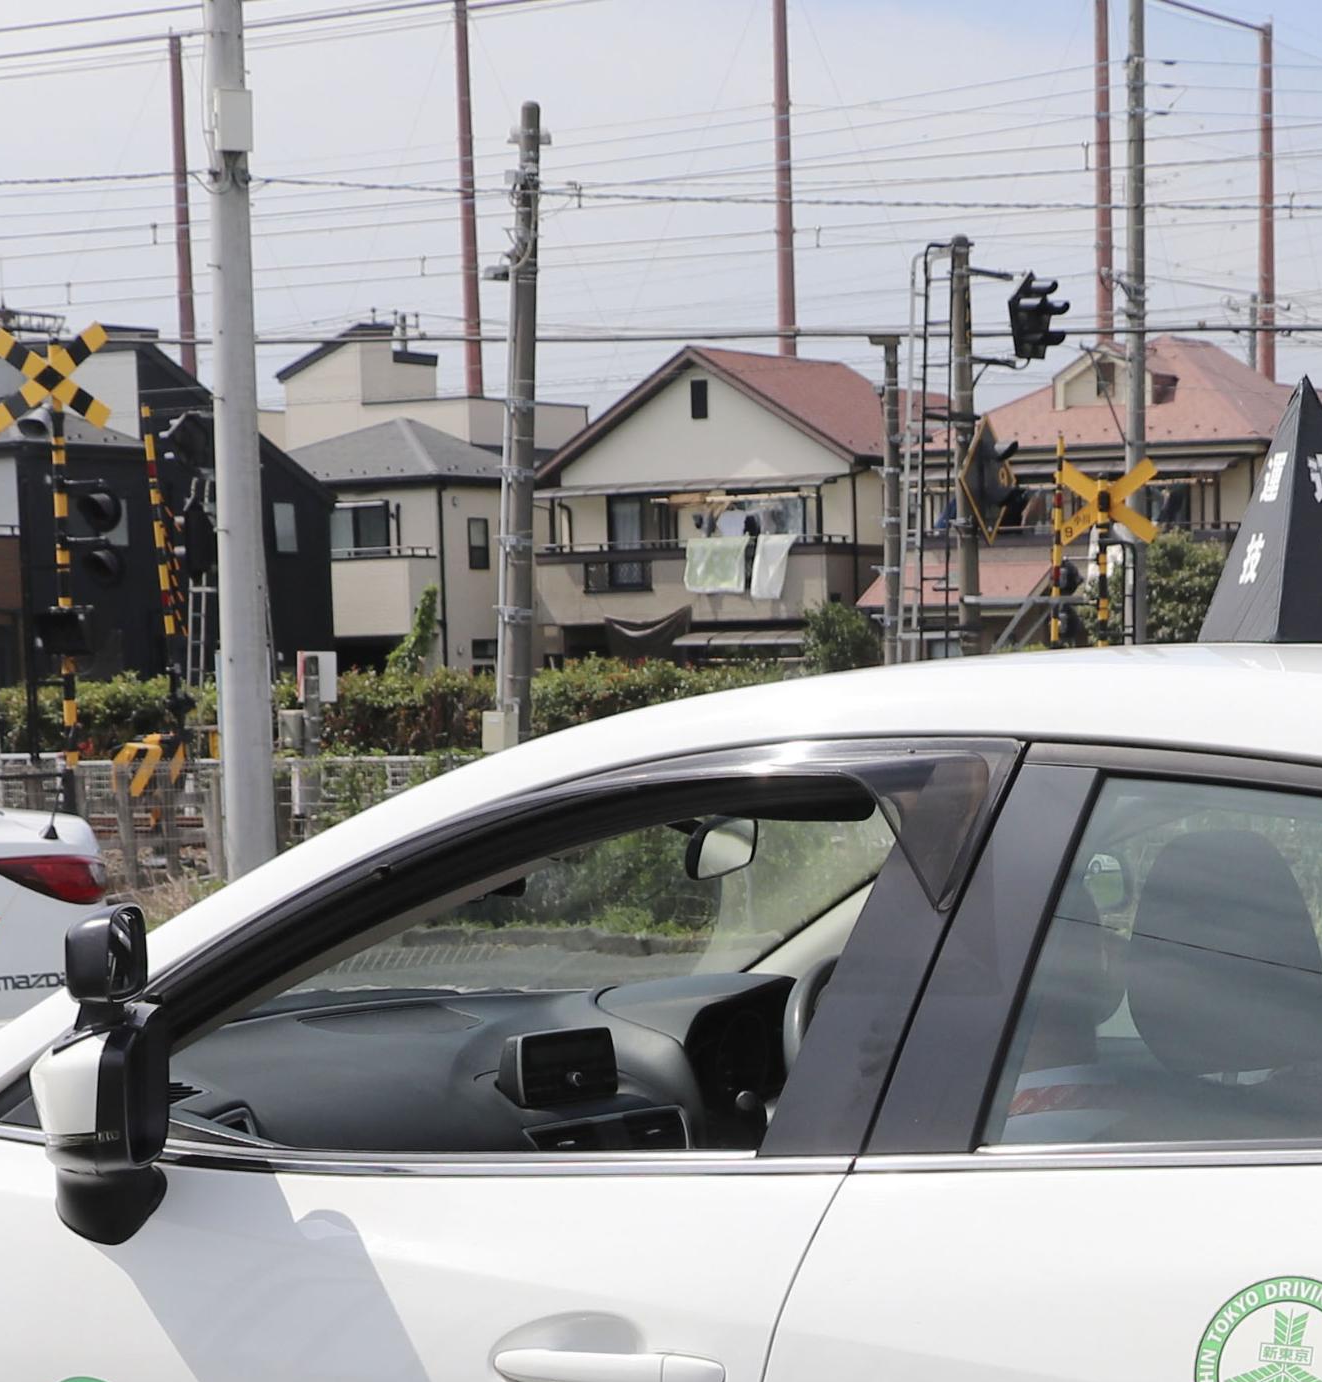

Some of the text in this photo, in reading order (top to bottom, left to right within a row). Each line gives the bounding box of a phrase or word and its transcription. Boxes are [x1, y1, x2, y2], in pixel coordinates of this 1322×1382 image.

[1239, 451, 1289, 584] 運技
[1207, 1290, 1260, 1343] TOKYO
[1262, 1346, 1310, 1361] 新東京
